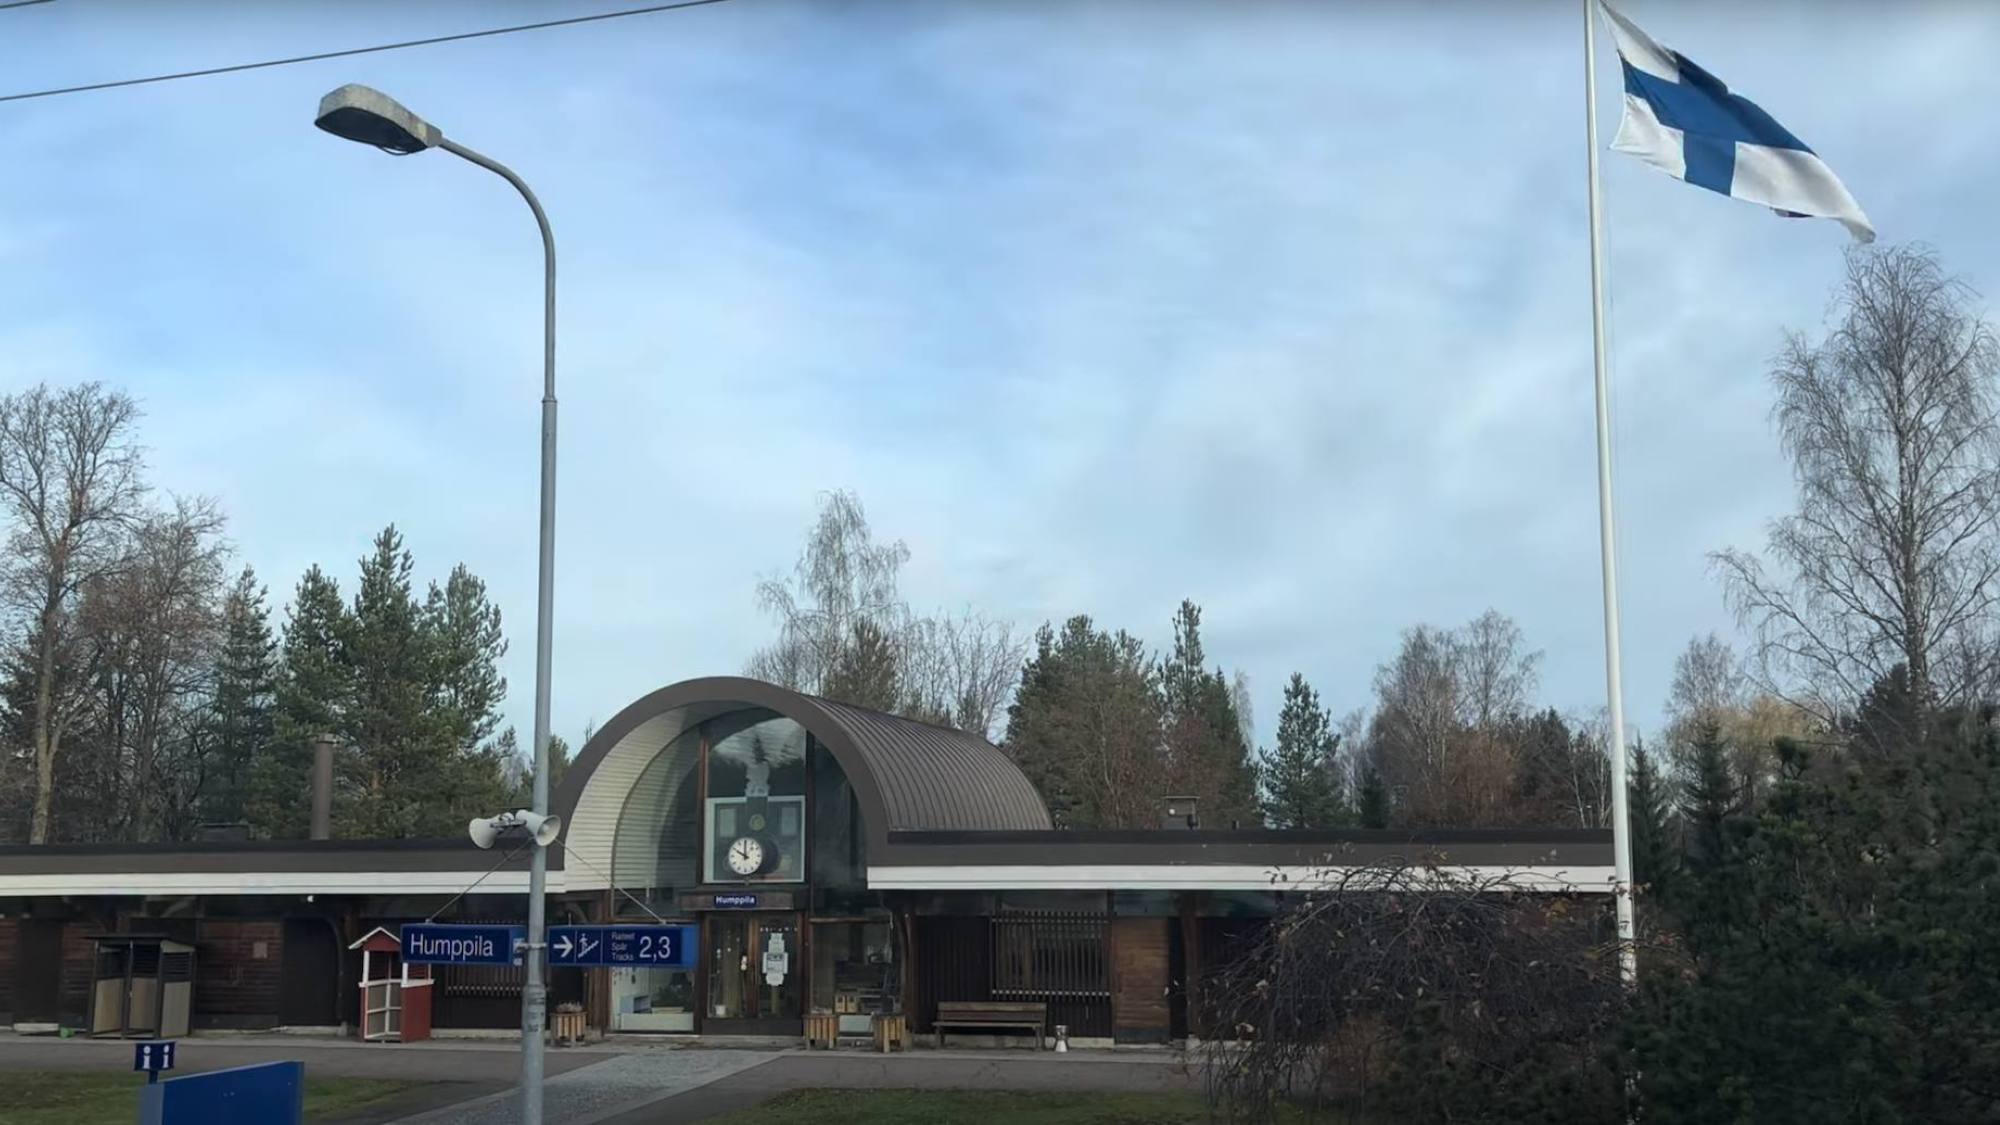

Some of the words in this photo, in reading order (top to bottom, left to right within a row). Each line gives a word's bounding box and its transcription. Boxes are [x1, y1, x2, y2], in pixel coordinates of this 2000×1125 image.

[715, 896, 755, 905] Humppila
[410, 933, 493, 961] Humppila
[639, 935, 671, 962] 2,3
